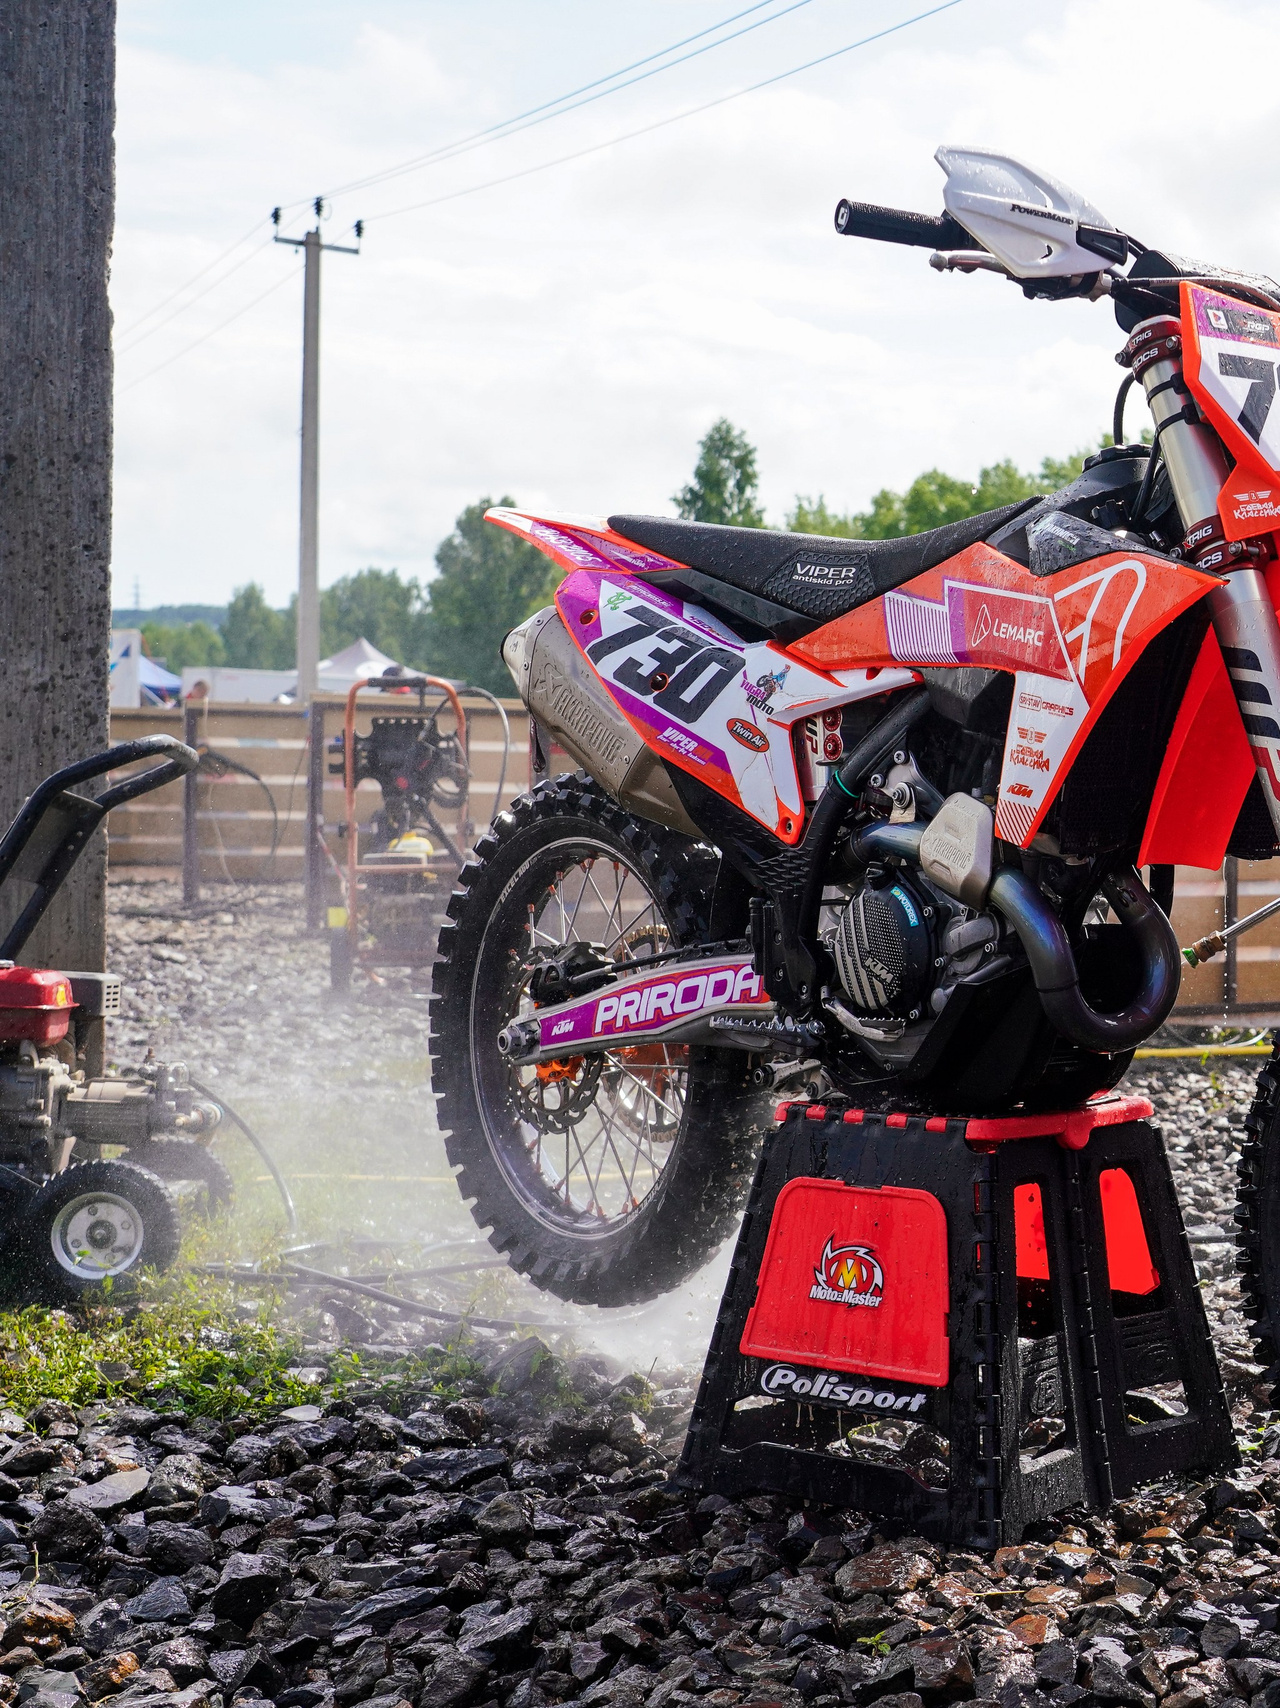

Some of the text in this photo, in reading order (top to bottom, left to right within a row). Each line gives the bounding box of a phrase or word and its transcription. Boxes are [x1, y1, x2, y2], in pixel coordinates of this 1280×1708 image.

[792, 573, 854, 586] antiskid pro
[795, 562, 856, 579] VIPER
[993, 618, 1045, 646] LEMARC
[587, 605, 746, 724] 730
[740, 679, 767, 700] YUGRA
[746, 695, 775, 715] MOTO
[1042, 701, 1074, 716] GRAPHICS
[662, 726, 699, 752] VIPER
[732, 721, 753, 740] Twin
[751, 735, 766, 747] Air
[1006, 783, 1034, 798] KTM
[898, 894, 917, 924] MOTOREX
[865, 957, 894, 984] KTM
[595, 964, 760, 1034] PRIRODA
[551, 1019, 574, 1036] KTM
[766, 1366, 927, 1413] Polisport
